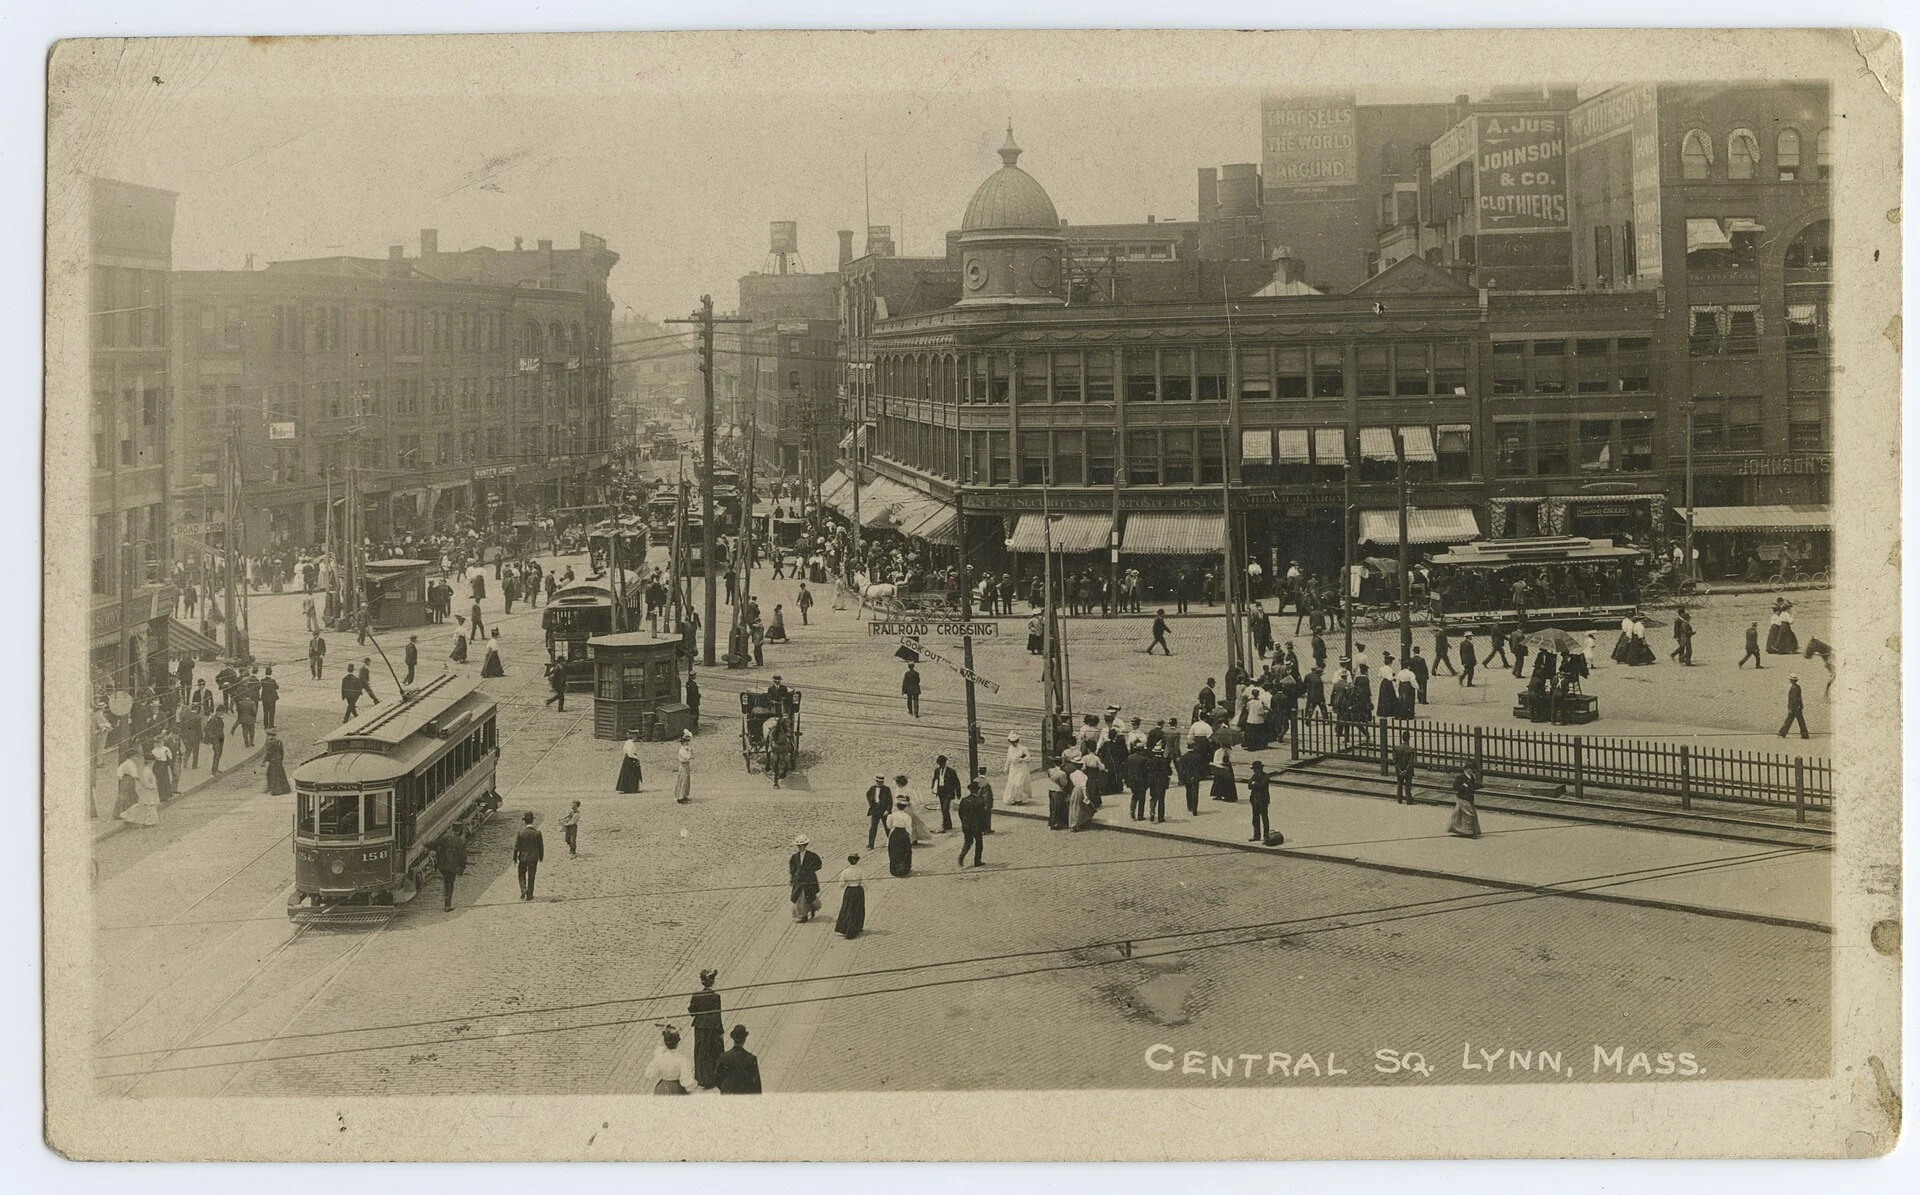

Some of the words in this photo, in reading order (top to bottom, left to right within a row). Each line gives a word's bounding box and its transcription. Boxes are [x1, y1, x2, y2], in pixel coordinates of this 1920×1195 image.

[1308, 108, 1352, 124] SELLS
[1486, 118, 1509, 134] A.
[1267, 135, 1296, 153] THE
[1298, 134, 1352, 151] WORLD
[1480, 140, 1563, 172] JOHNSON
[1276, 160, 1349, 178] AROUND.
[1500, 172, 1515, 186] &
[1521, 171, 1556, 186] CO.
[1480, 194, 1566, 222] CLOTHIERS
[1739, 457, 1831, 476] JOHNSON'S
[1118, 499, 1163, 508] EPOSIT
[1171, 498, 1207, 508] TRUST
[873, 624, 929, 636] RAILROAD
[936, 624, 993, 636] CROSSING
[900, 636, 923, 654] LOOK
[924, 649, 942, 664] OUT
[362, 850, 388, 862] 158
